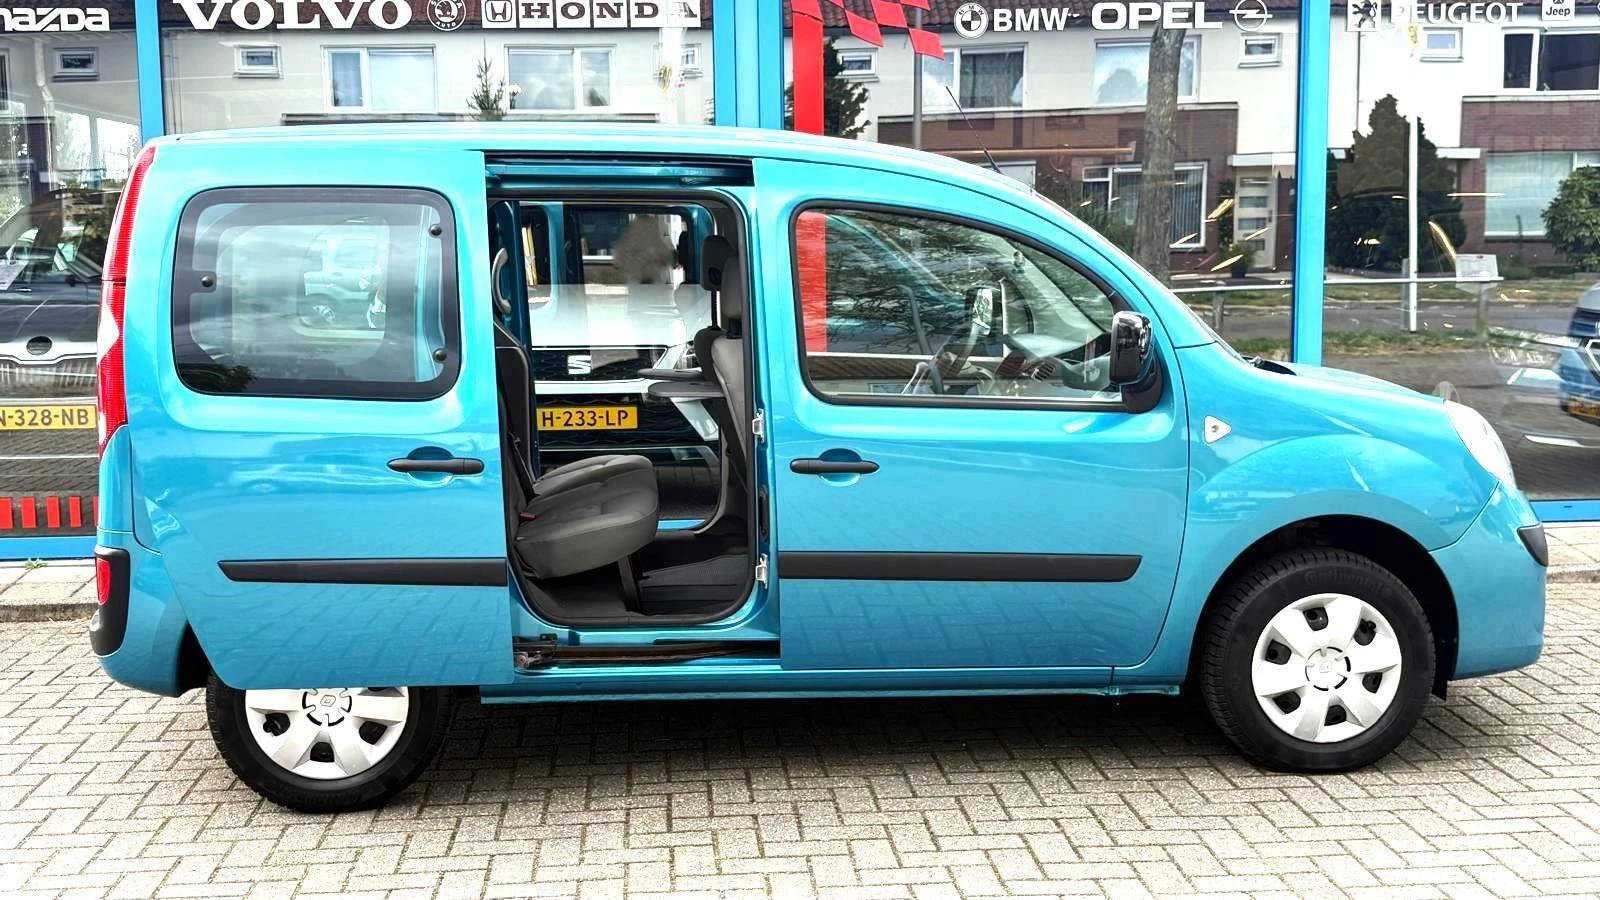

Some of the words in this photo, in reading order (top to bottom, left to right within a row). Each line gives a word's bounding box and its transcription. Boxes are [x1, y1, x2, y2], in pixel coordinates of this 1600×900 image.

[173, 0, 412, 29] VOLVO
[993, 8, 1069, 31] BMW
[1092, 2, 1223, 29] OPEL
[1391, 2, 1523, 24] PEUGEOT
[1545, 6, 1571, 16] Jeep
[542, 410, 628, 427] H-233-LP
